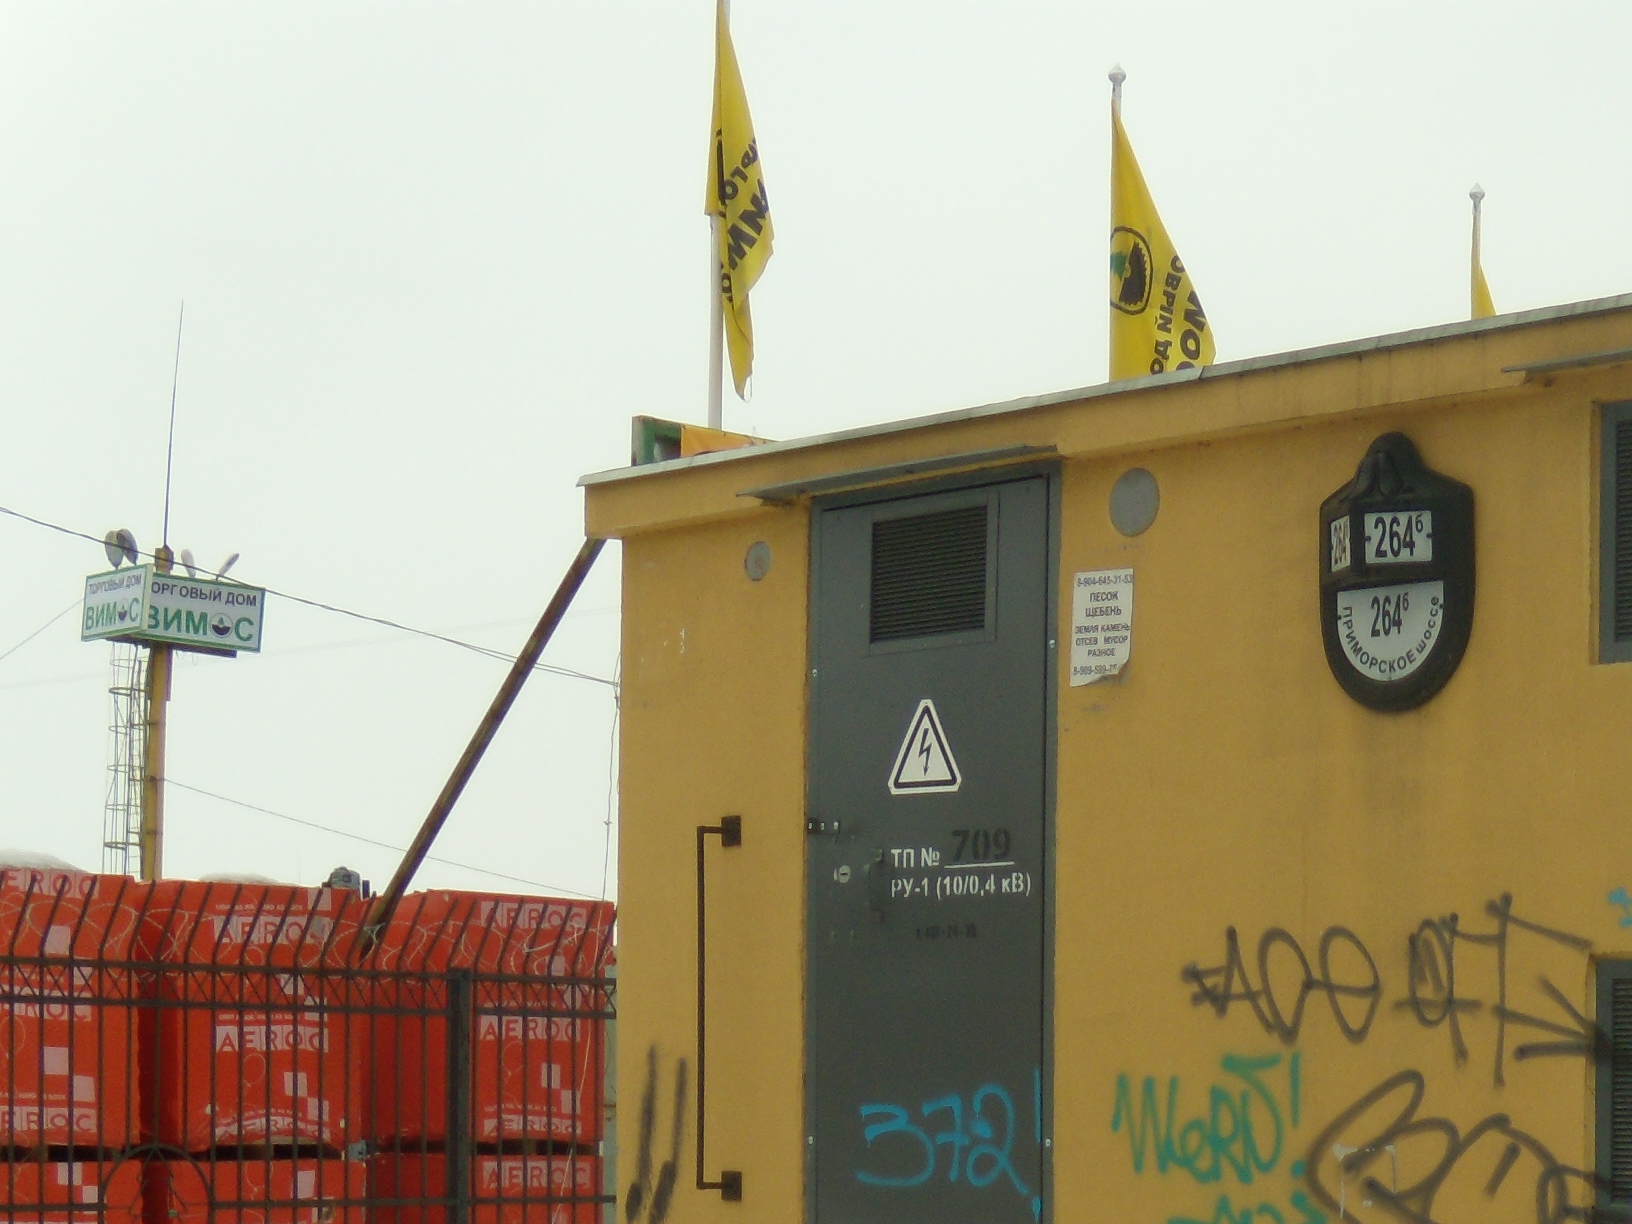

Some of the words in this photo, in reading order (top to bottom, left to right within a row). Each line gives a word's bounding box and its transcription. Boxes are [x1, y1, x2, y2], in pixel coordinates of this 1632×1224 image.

[151, 581, 222, 602] ОРГОВЫЙ
[225, 592, 257, 607] ДОМ
[1089, 591, 1118, 602] ПЕСОК
[1085, 606, 1122, 618] ЩЕБЕНЬ
[1343, 606, 1417, 673] ПРИМОРСКОЕ
[891, 849, 915, 868] ТП
[951, 828, 1011, 861] 709
[891, 877, 929, 898] РУ-1
